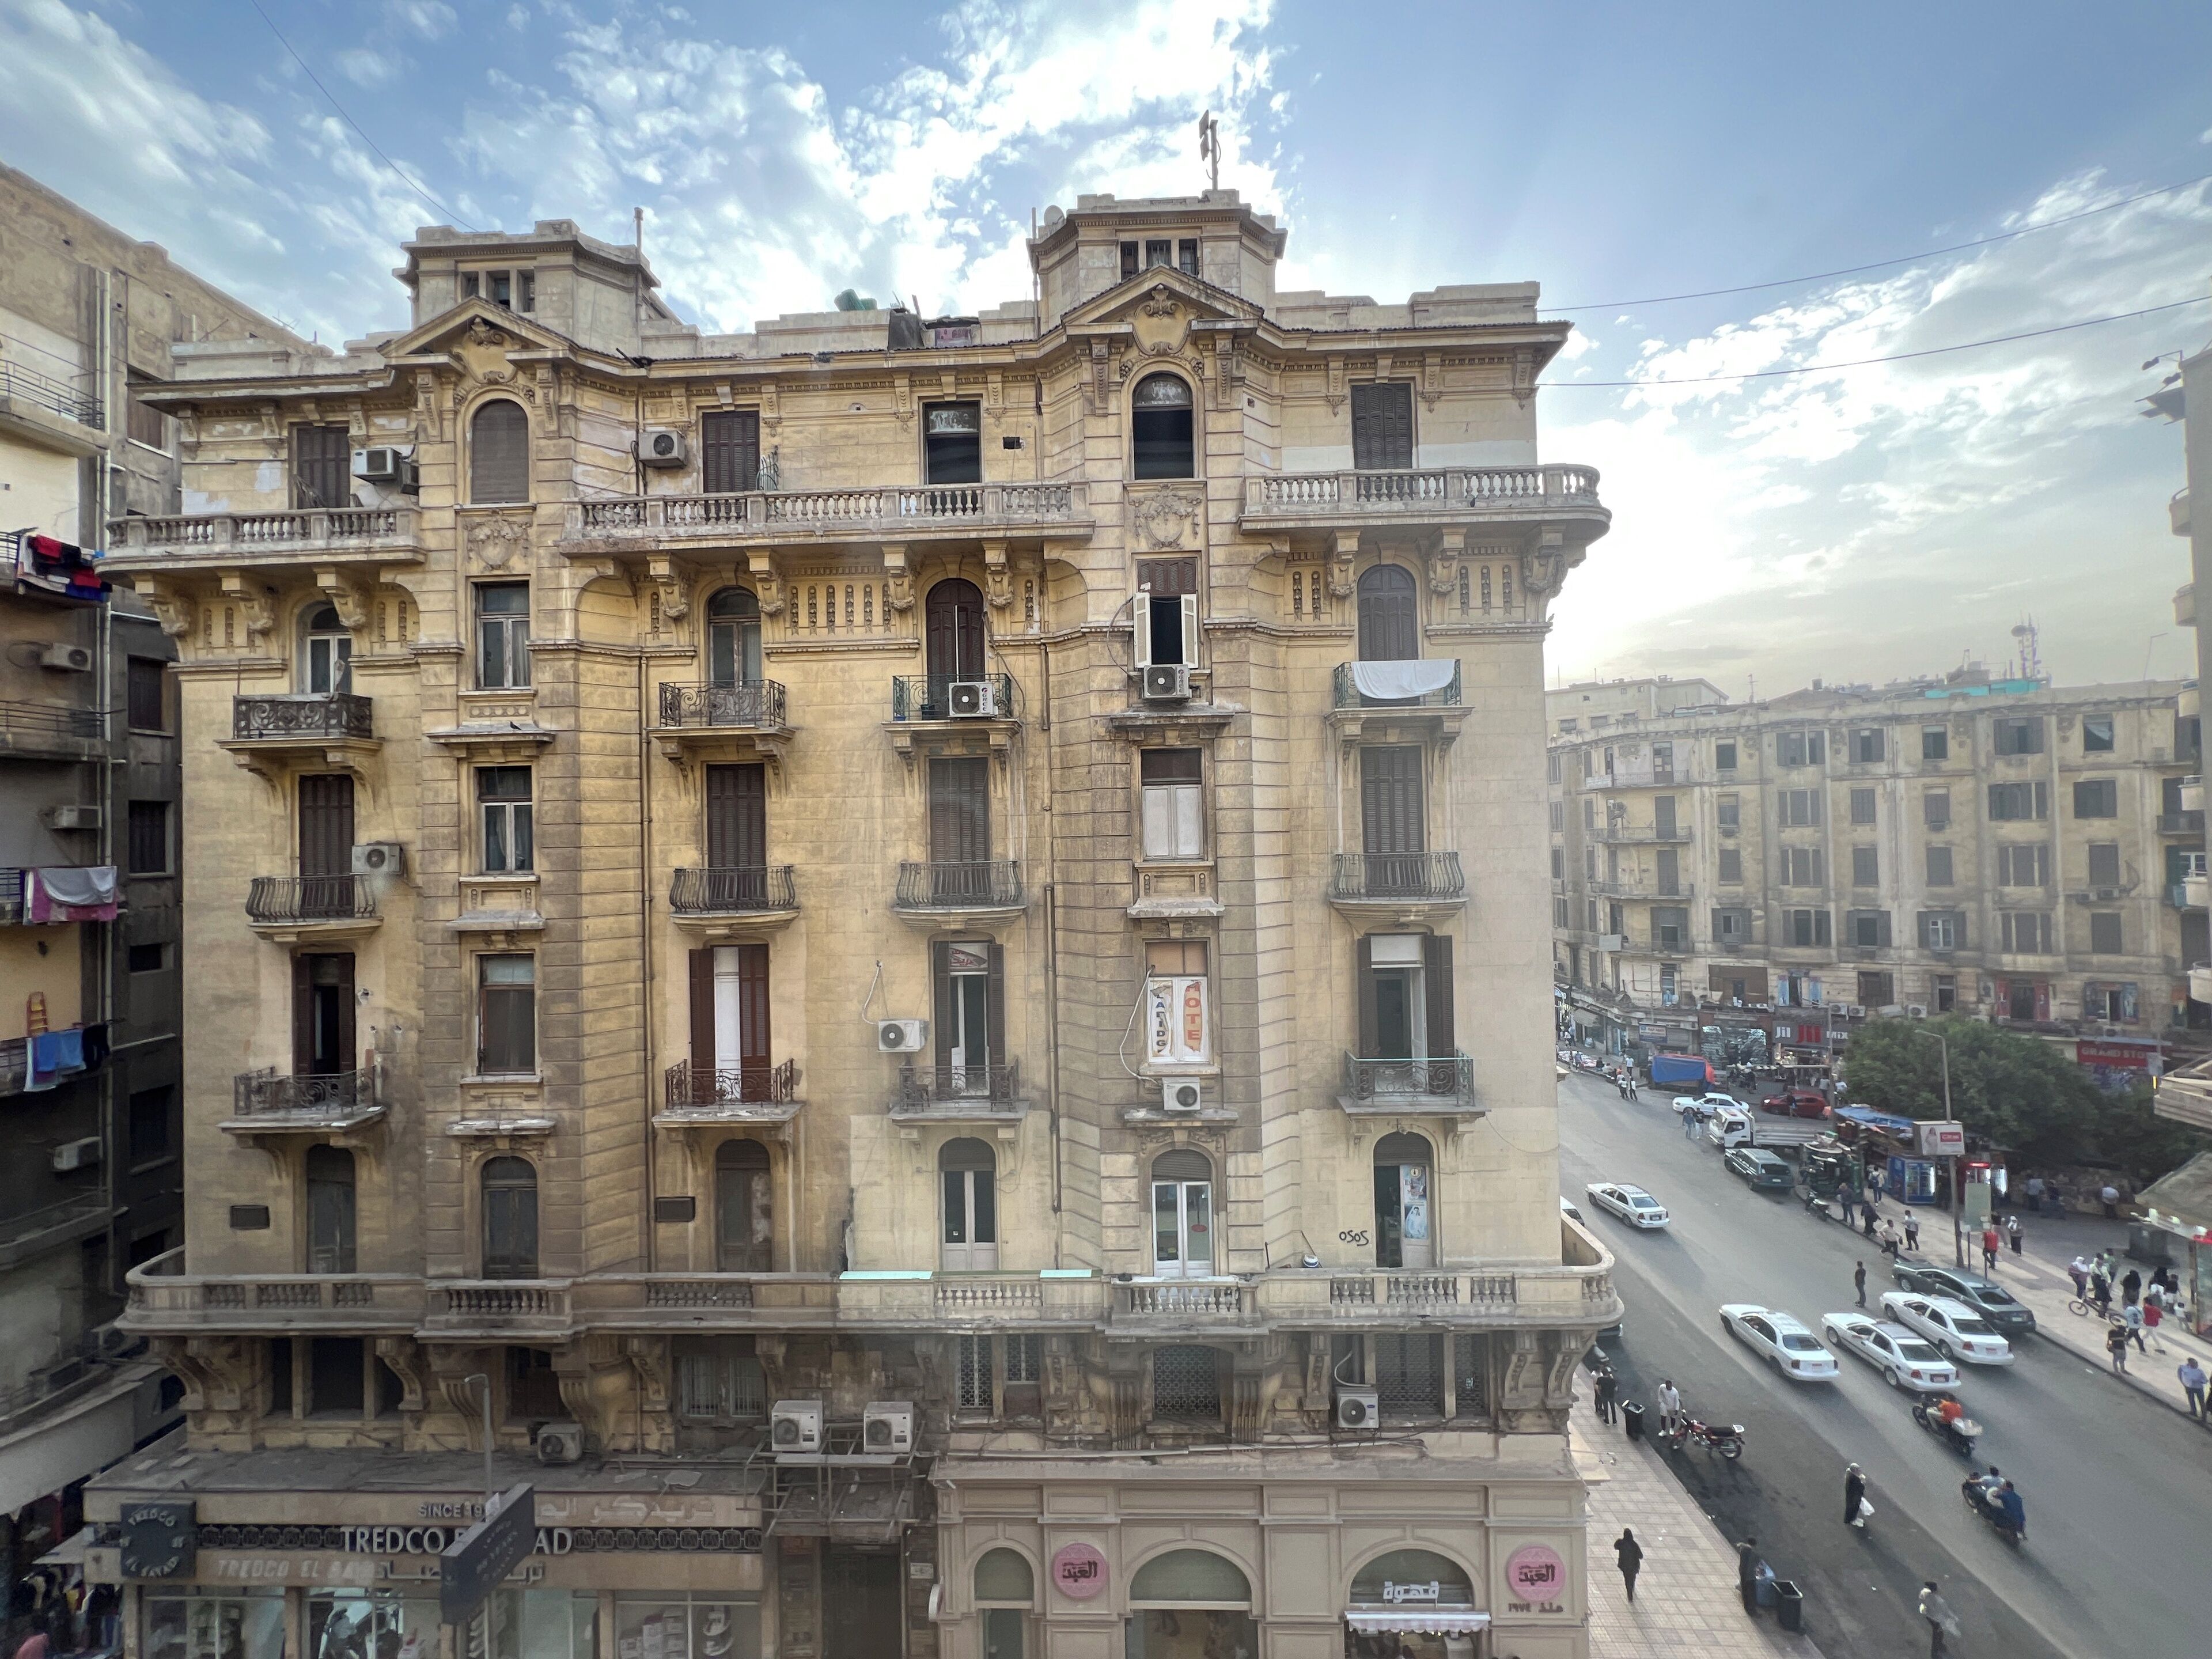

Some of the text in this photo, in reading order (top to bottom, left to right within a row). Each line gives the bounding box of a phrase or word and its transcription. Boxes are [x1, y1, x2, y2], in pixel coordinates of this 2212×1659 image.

[1184, 981, 1201, 1050] HOTE
[2123, 1050, 2146, 1059] STO
[128, 1508, 176, 1527] TREDCO
[418, 1505, 461, 1517] SINCE
[340, 1527, 444, 1554] TREDCO
[1383, 1581, 1440, 1603] قهوة
[1538, 1602, 1564, 1613] منذ
